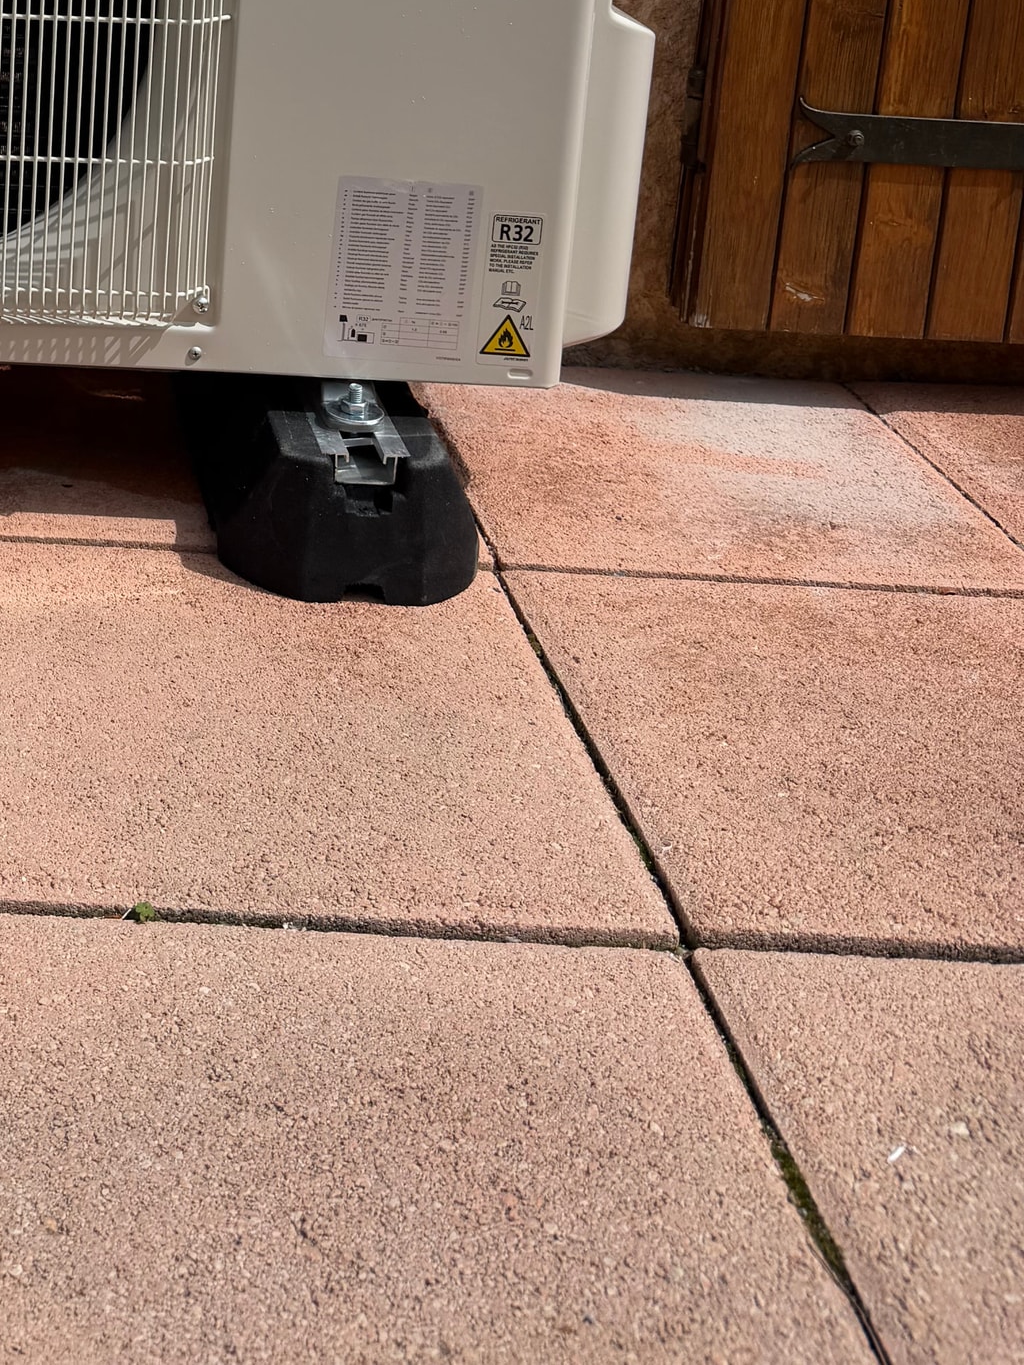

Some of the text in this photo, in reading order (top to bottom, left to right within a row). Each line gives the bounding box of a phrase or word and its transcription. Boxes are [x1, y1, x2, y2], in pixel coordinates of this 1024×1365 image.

[496, 217, 540, 225] REFRIGERANT
[500, 224, 534, 242] R32
[519, 315, 534, 331] A2L
